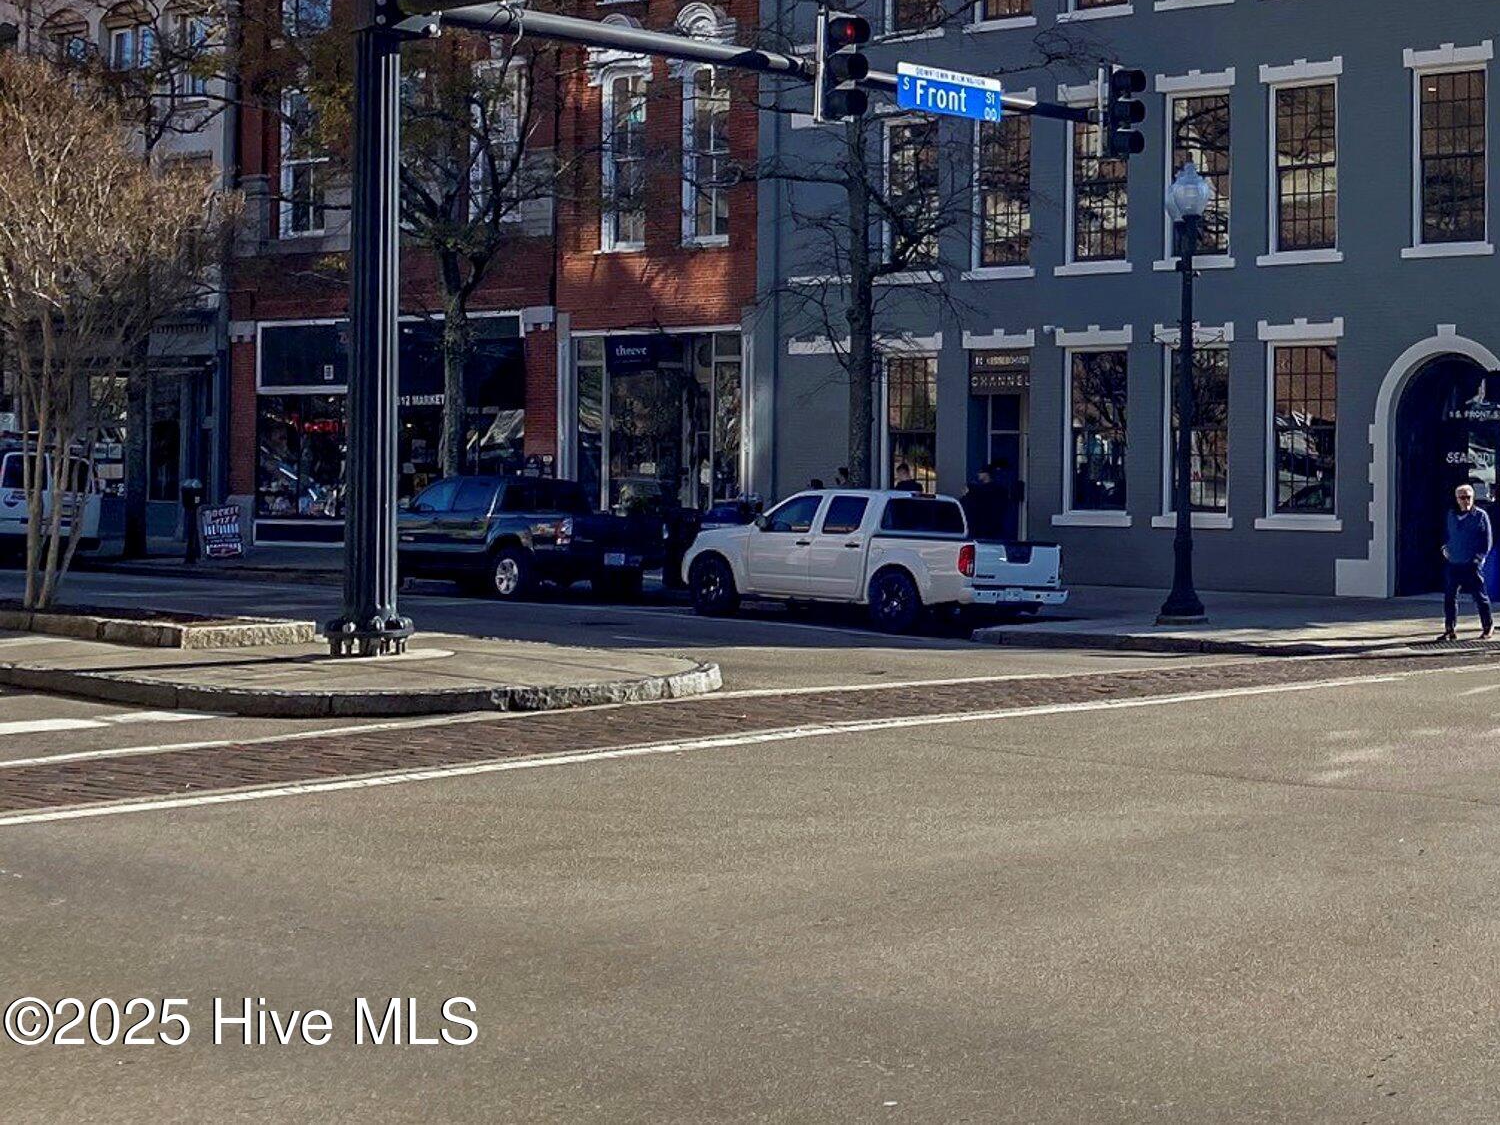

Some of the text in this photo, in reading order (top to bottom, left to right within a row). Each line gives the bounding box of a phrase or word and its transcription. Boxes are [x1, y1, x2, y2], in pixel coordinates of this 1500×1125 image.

[902, 77, 996, 113] S Front St
